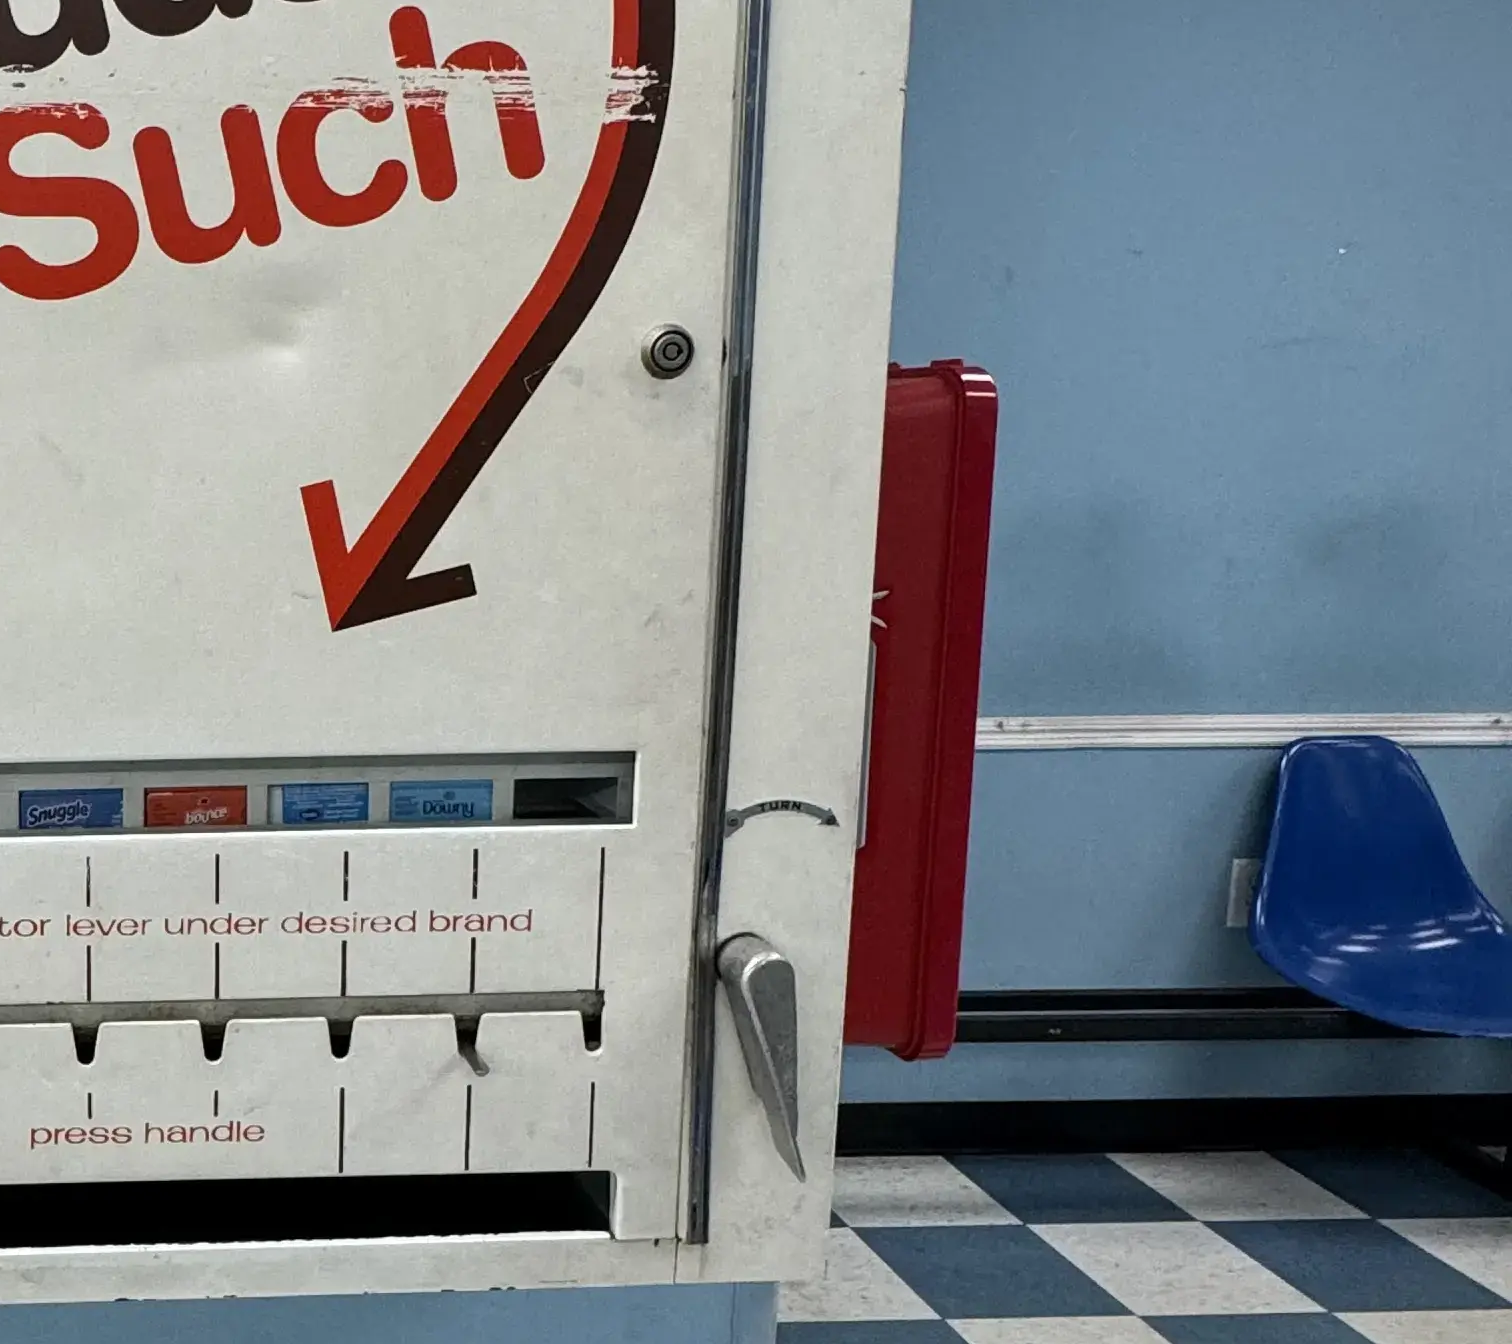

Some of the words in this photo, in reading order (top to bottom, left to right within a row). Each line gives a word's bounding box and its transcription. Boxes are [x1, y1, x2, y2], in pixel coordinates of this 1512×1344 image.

[27, 799, 91, 827] Snuggle
[184, 807, 228, 825] bounce
[421, 800, 474, 818] Downy
[759, 800, 802, 812] TURN
[65, 914, 152, 937] lever
[164, 912, 269, 936] under
[280, 909, 417, 934] desired
[428, 908, 533, 932] brand
[30, 1126, 133, 1150] press
[144, 1120, 265, 1144] handle
